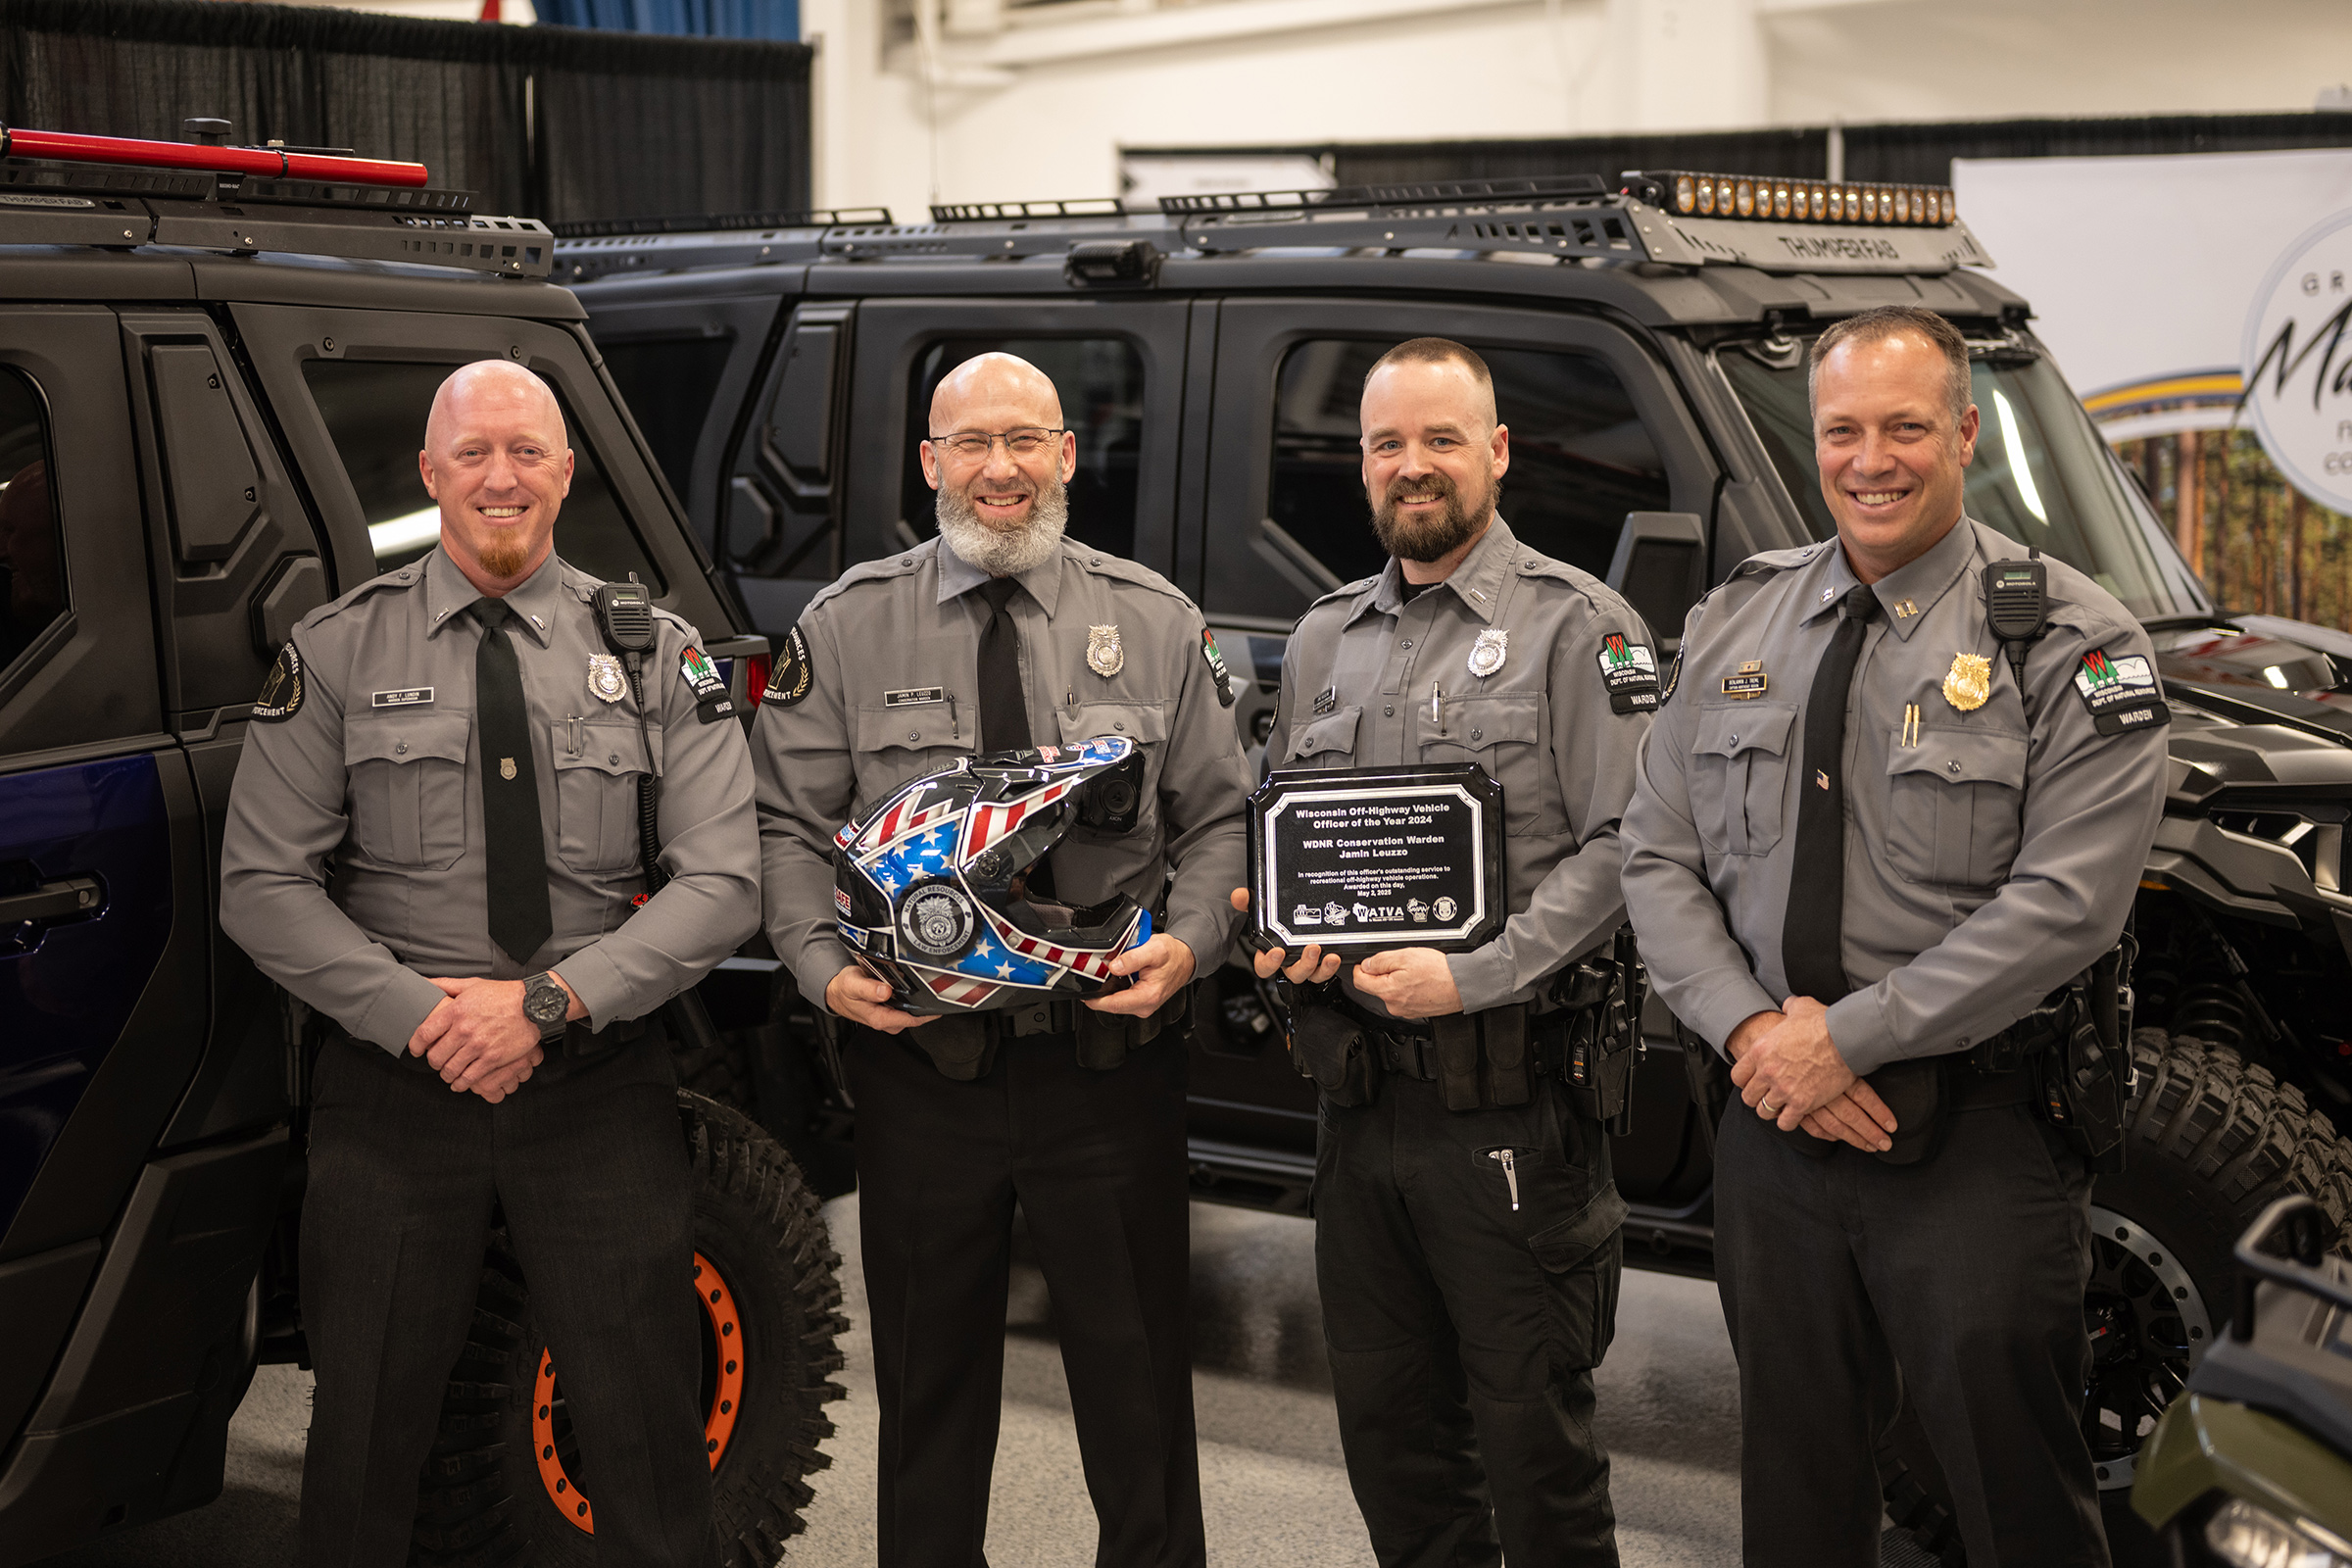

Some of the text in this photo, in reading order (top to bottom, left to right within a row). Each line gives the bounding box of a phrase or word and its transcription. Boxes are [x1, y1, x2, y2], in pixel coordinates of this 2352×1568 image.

[1630, 694, 1657, 706] WARDEN
[2118, 709, 2154, 725] WARDEN
[1296, 804, 1450, 818] Wisconsin Off-Highway Vehicle
[1313, 814, 1433, 829] Officer of the Year 2024
[1302, 834, 1445, 849] WDNR Conservation Warden
[1339, 849, 1408, 859] Jamin Leuzzo
[905, 886, 964, 913] NATURAL RESOURCES
[913, 930, 970, 954] LAW ENFORCEMENT
